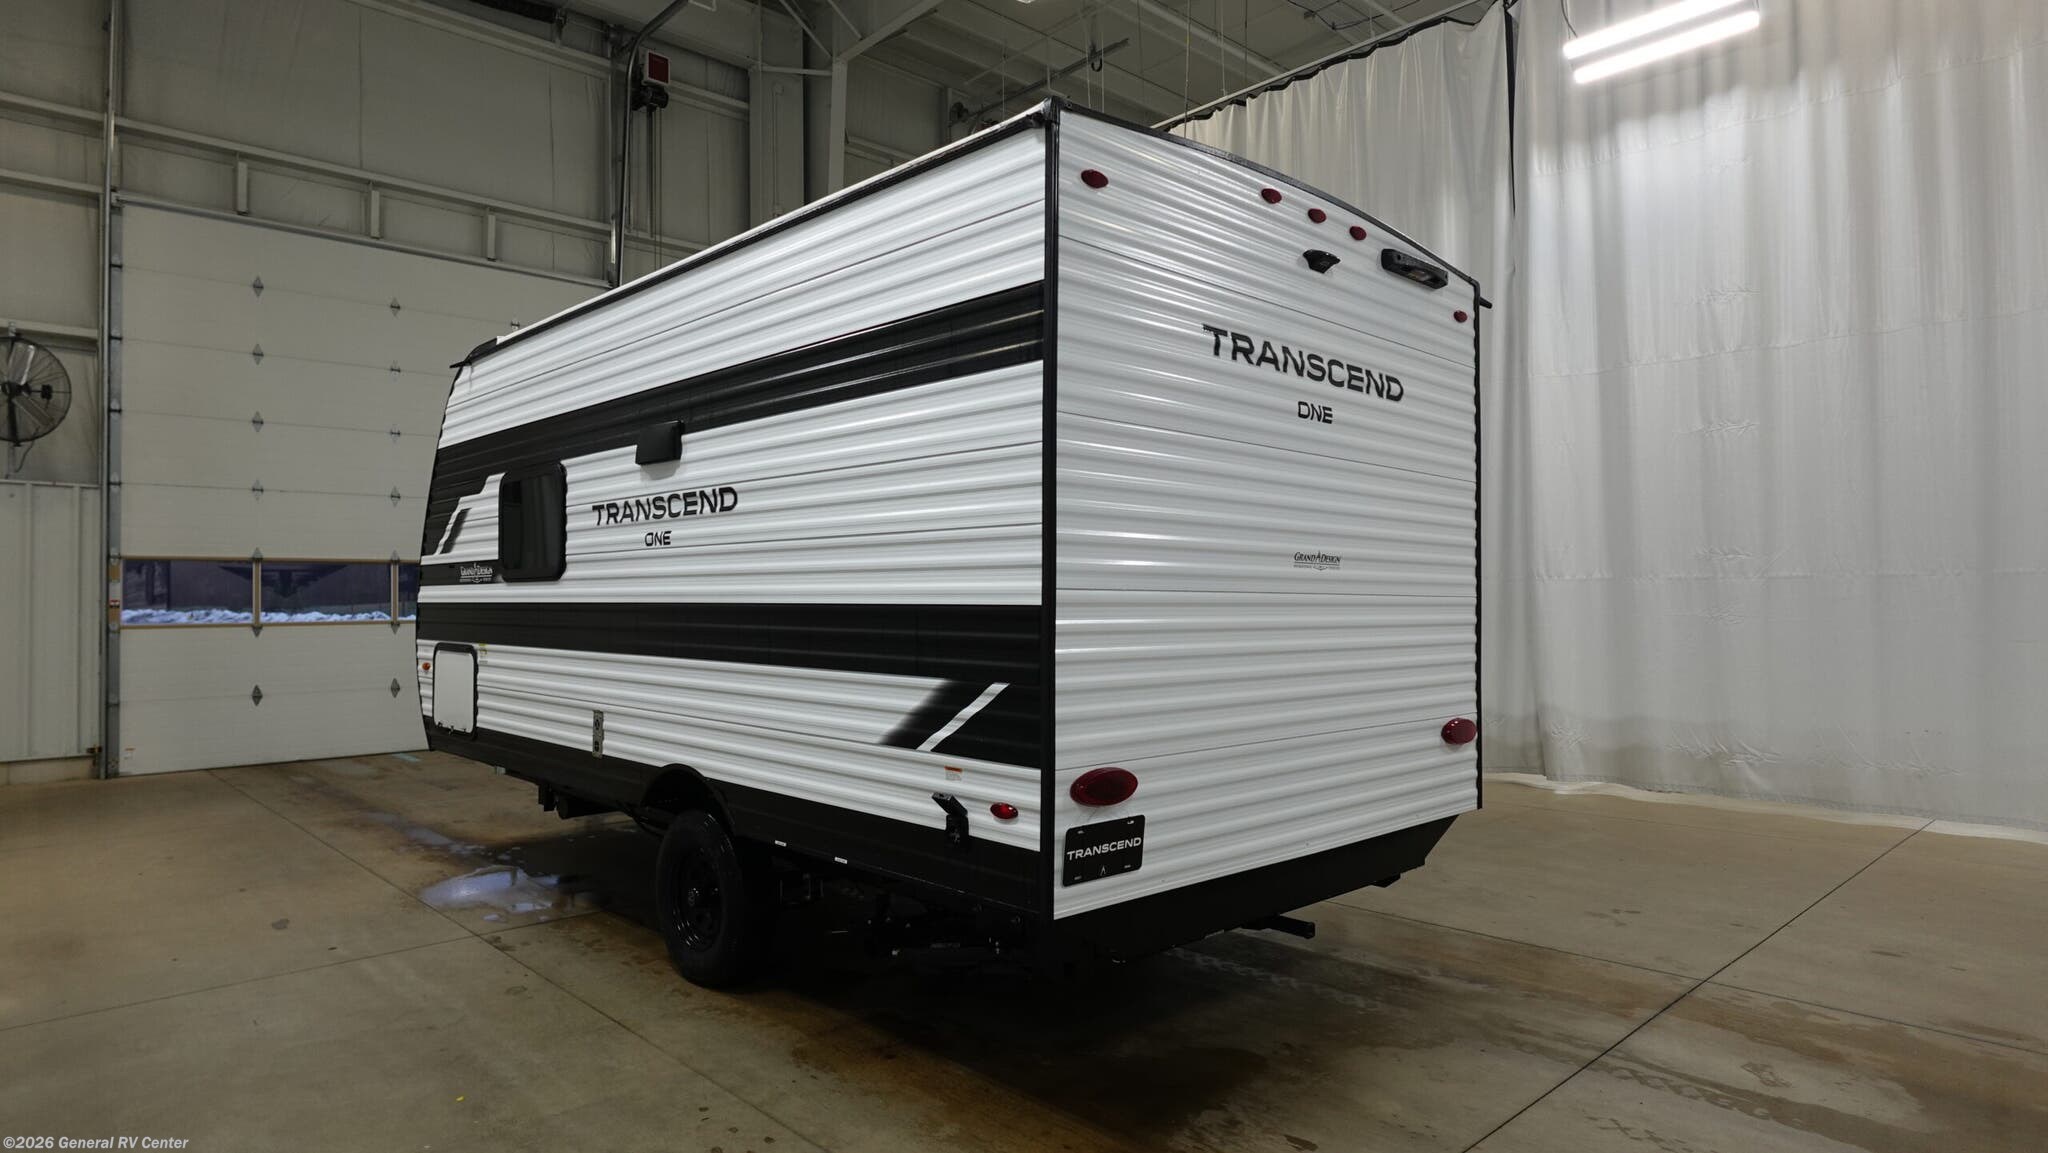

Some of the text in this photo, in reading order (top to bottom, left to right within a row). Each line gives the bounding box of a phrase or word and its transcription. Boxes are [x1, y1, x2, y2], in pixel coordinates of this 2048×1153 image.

[1202, 324, 1404, 402] TRANSCEND
[1297, 401, 1333, 424] ONE
[592, 486, 738, 526] TRANSCEND
[644, 530, 672, 547] ONE
[1066, 837, 1142, 861] TRANSCEND
